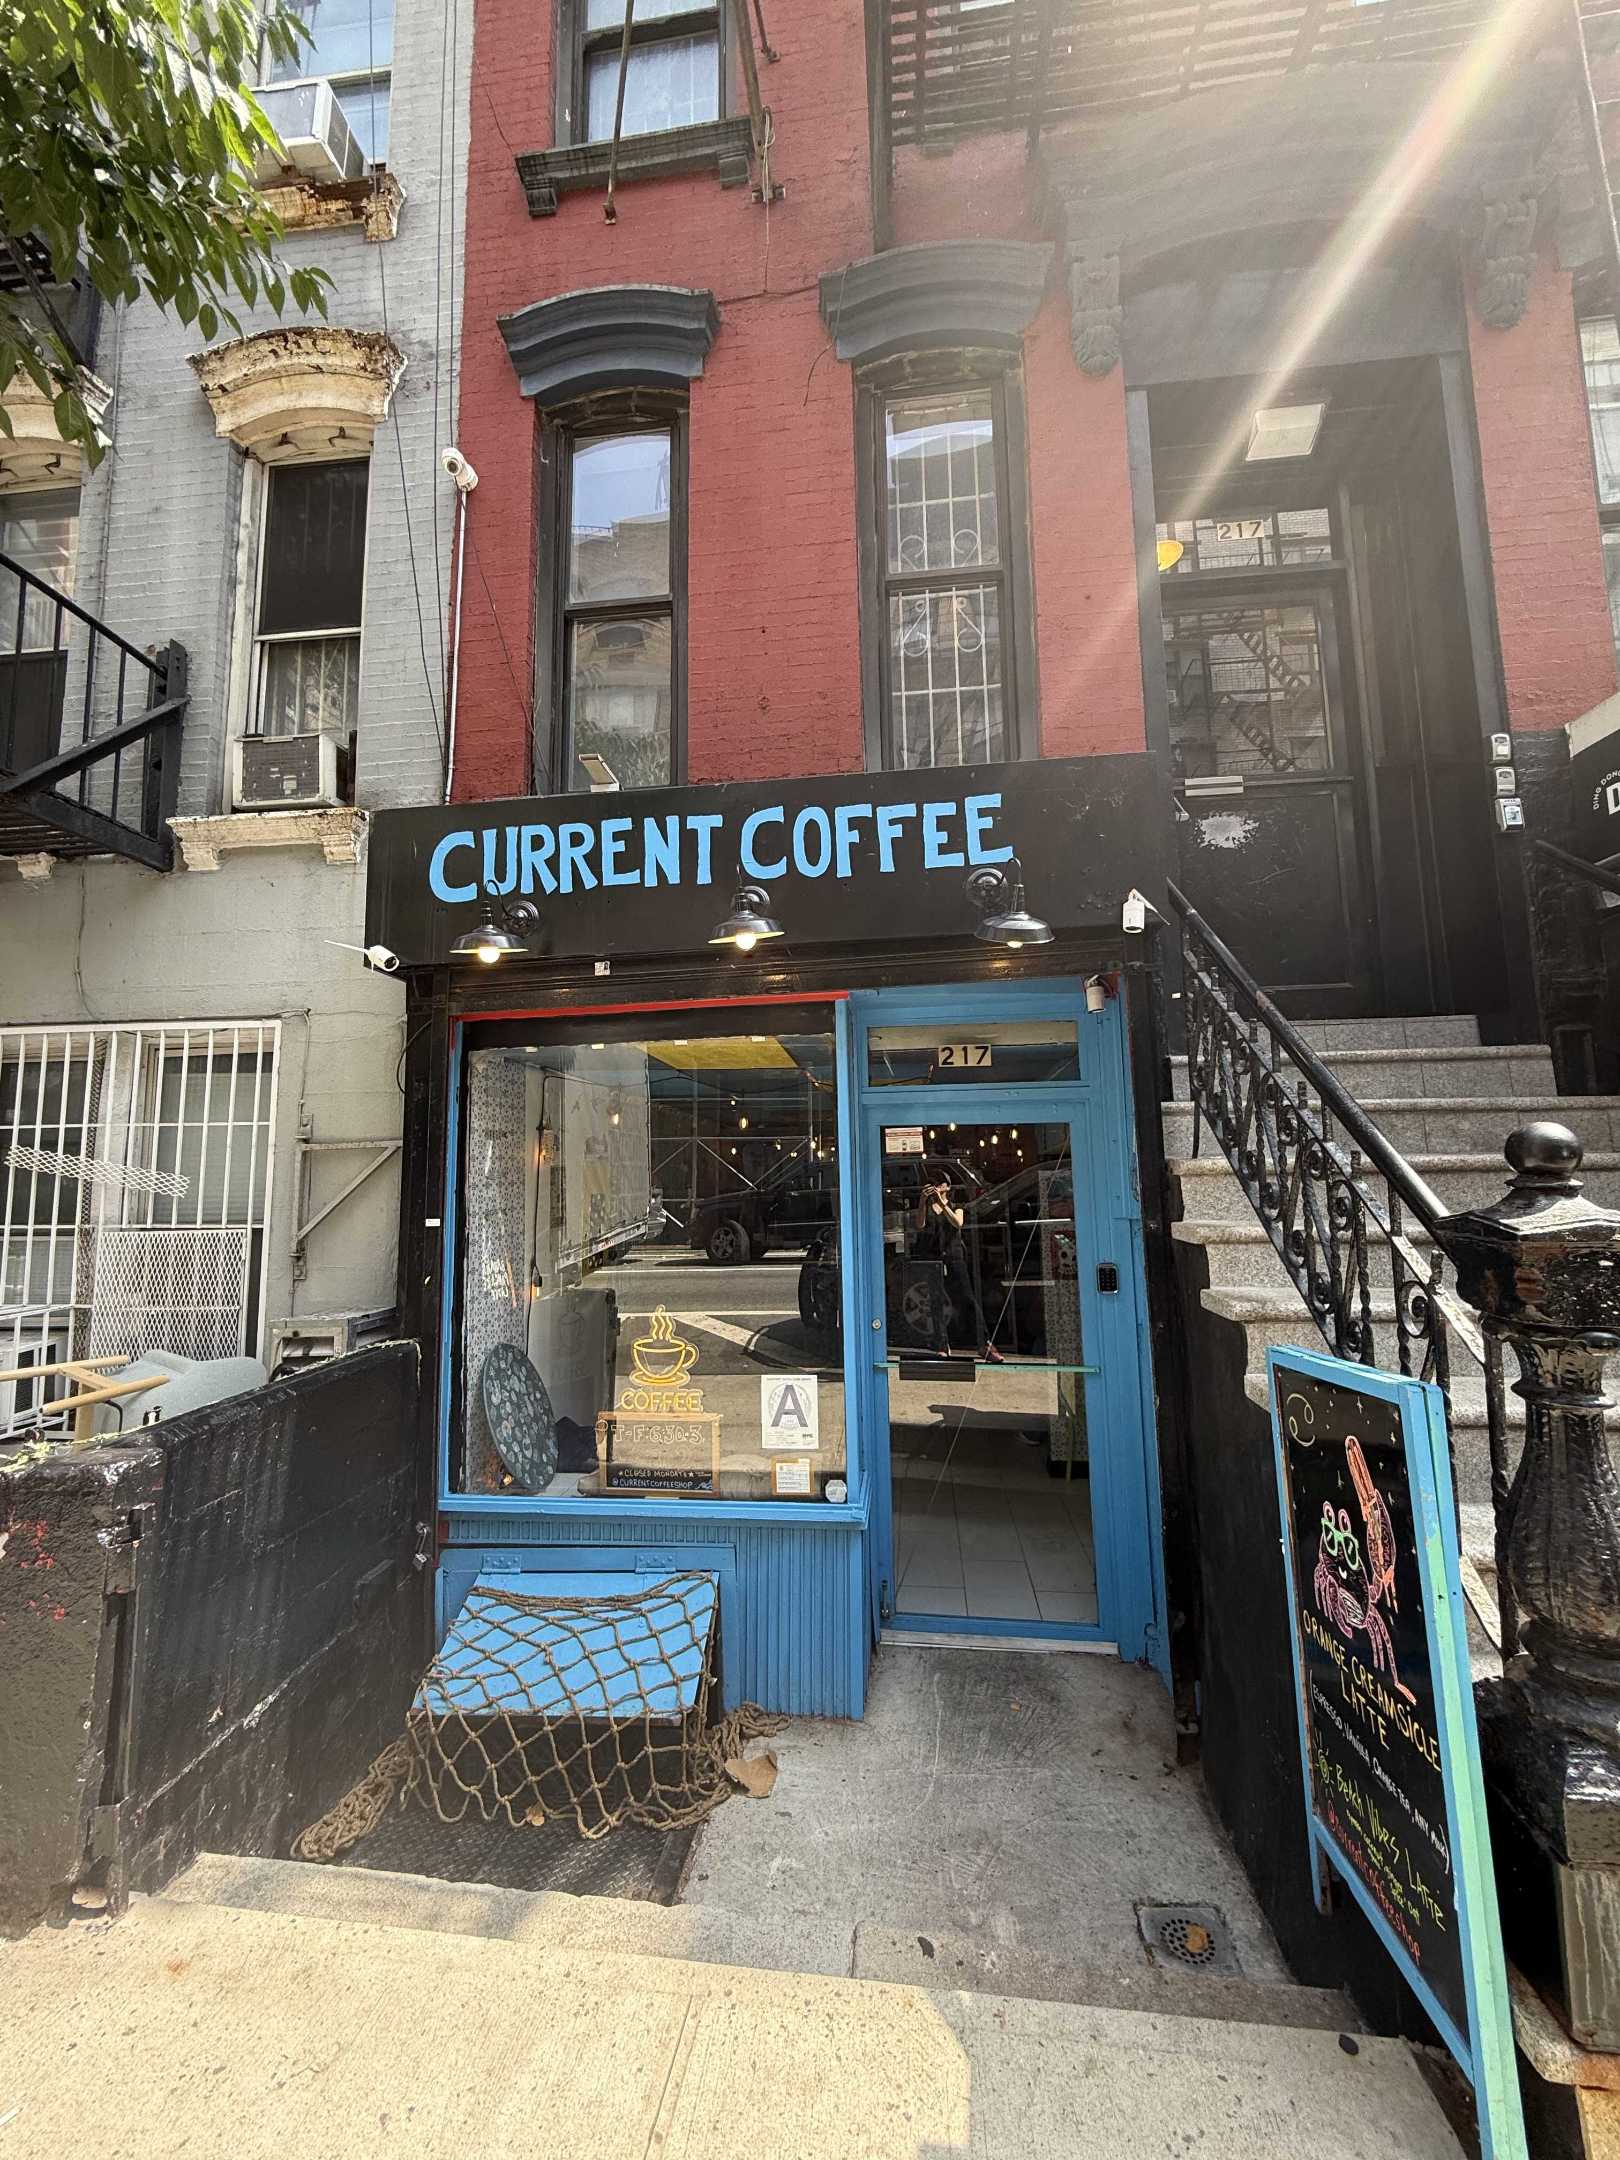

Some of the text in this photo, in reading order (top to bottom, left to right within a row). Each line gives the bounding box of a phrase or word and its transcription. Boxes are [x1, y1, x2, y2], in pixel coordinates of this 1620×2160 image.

[1219, 520, 1262, 540] 217
[1592, 786, 1602, 810] DING
[429, 793, 1015, 904] CURRENT COFFEE
[941, 1045, 989, 1065] 217
[620, 1390, 702, 1412] COFFEE
[770, 1384, 808, 1428] A
[624, 1468, 652, 1478] CLOSED
[1303, 1609, 1349, 1673] ORANGE
[1340, 1669, 1390, 1751] LATTE
